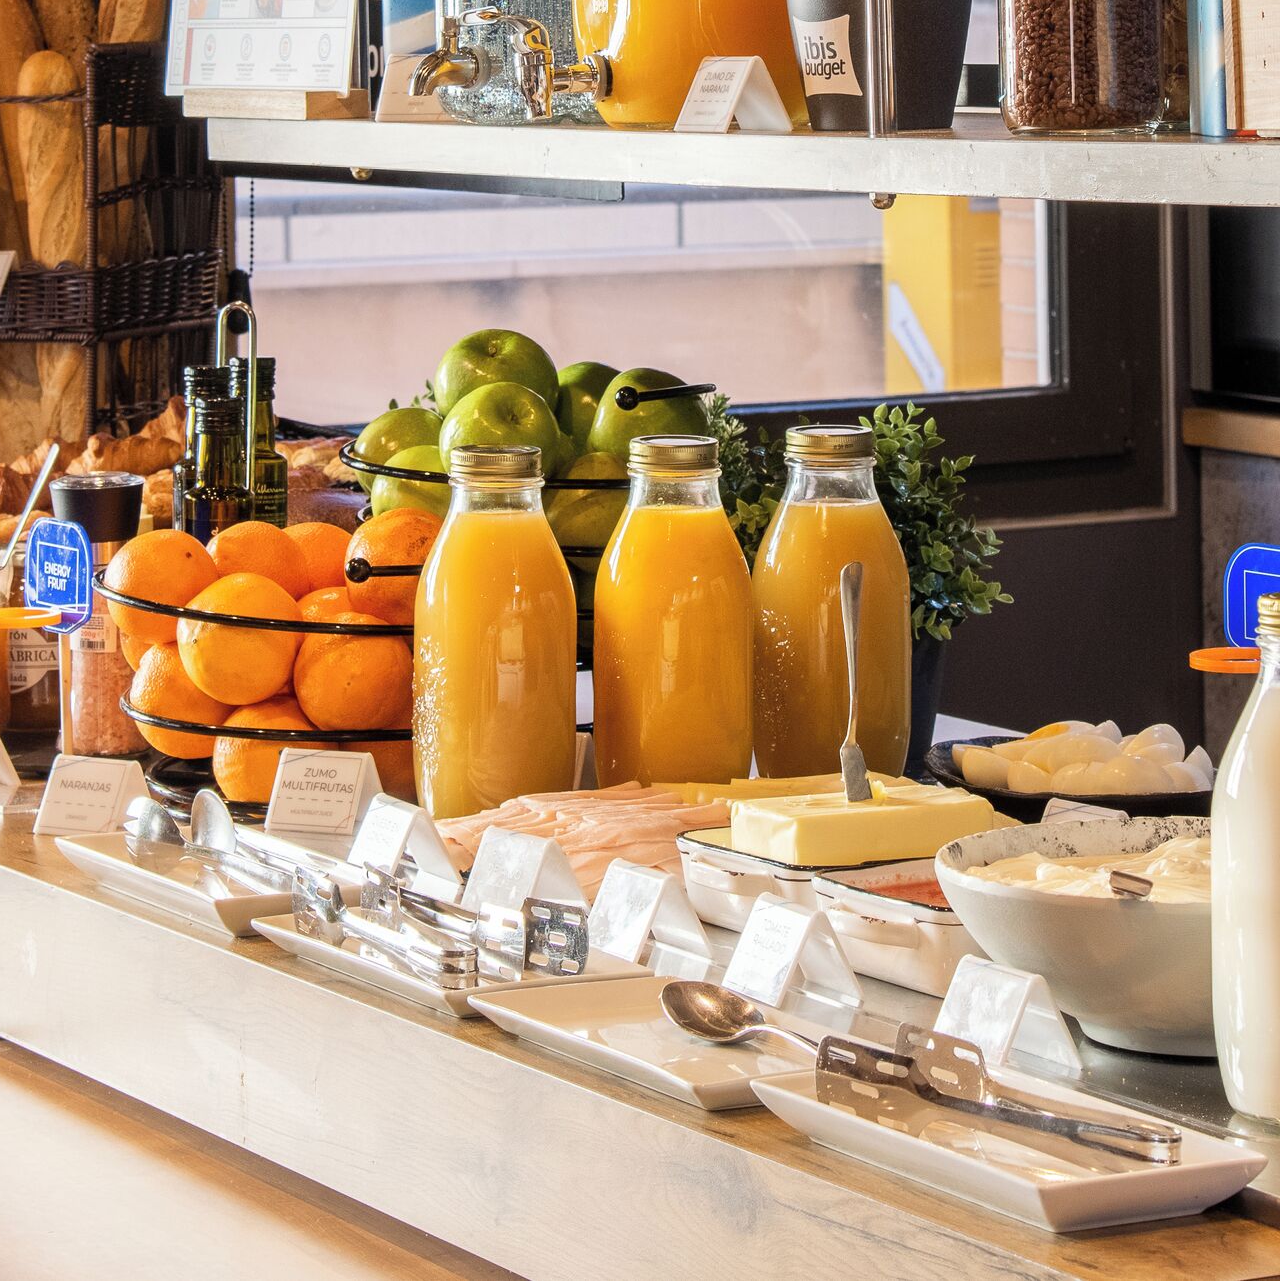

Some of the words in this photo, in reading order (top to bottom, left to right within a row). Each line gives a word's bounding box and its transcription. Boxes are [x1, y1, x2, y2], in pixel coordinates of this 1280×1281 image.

[803, 35, 837, 60] ibis
[704, 71, 726, 81] ZUMO
[726, 71, 736, 81] DE
[804, 59, 846, 80] budget
[700, 84, 731, 94] NARANJA
[43, 560, 72, 579] ENERGY
[46, 576, 68, 592] FRUIT
[9, 647, 57, 663] ÁBRICA
[304, 767, 338, 779] ZUMO
[60, 779, 112, 793] NARANJAS
[281, 781, 354, 794] MULTIFRUTAS
